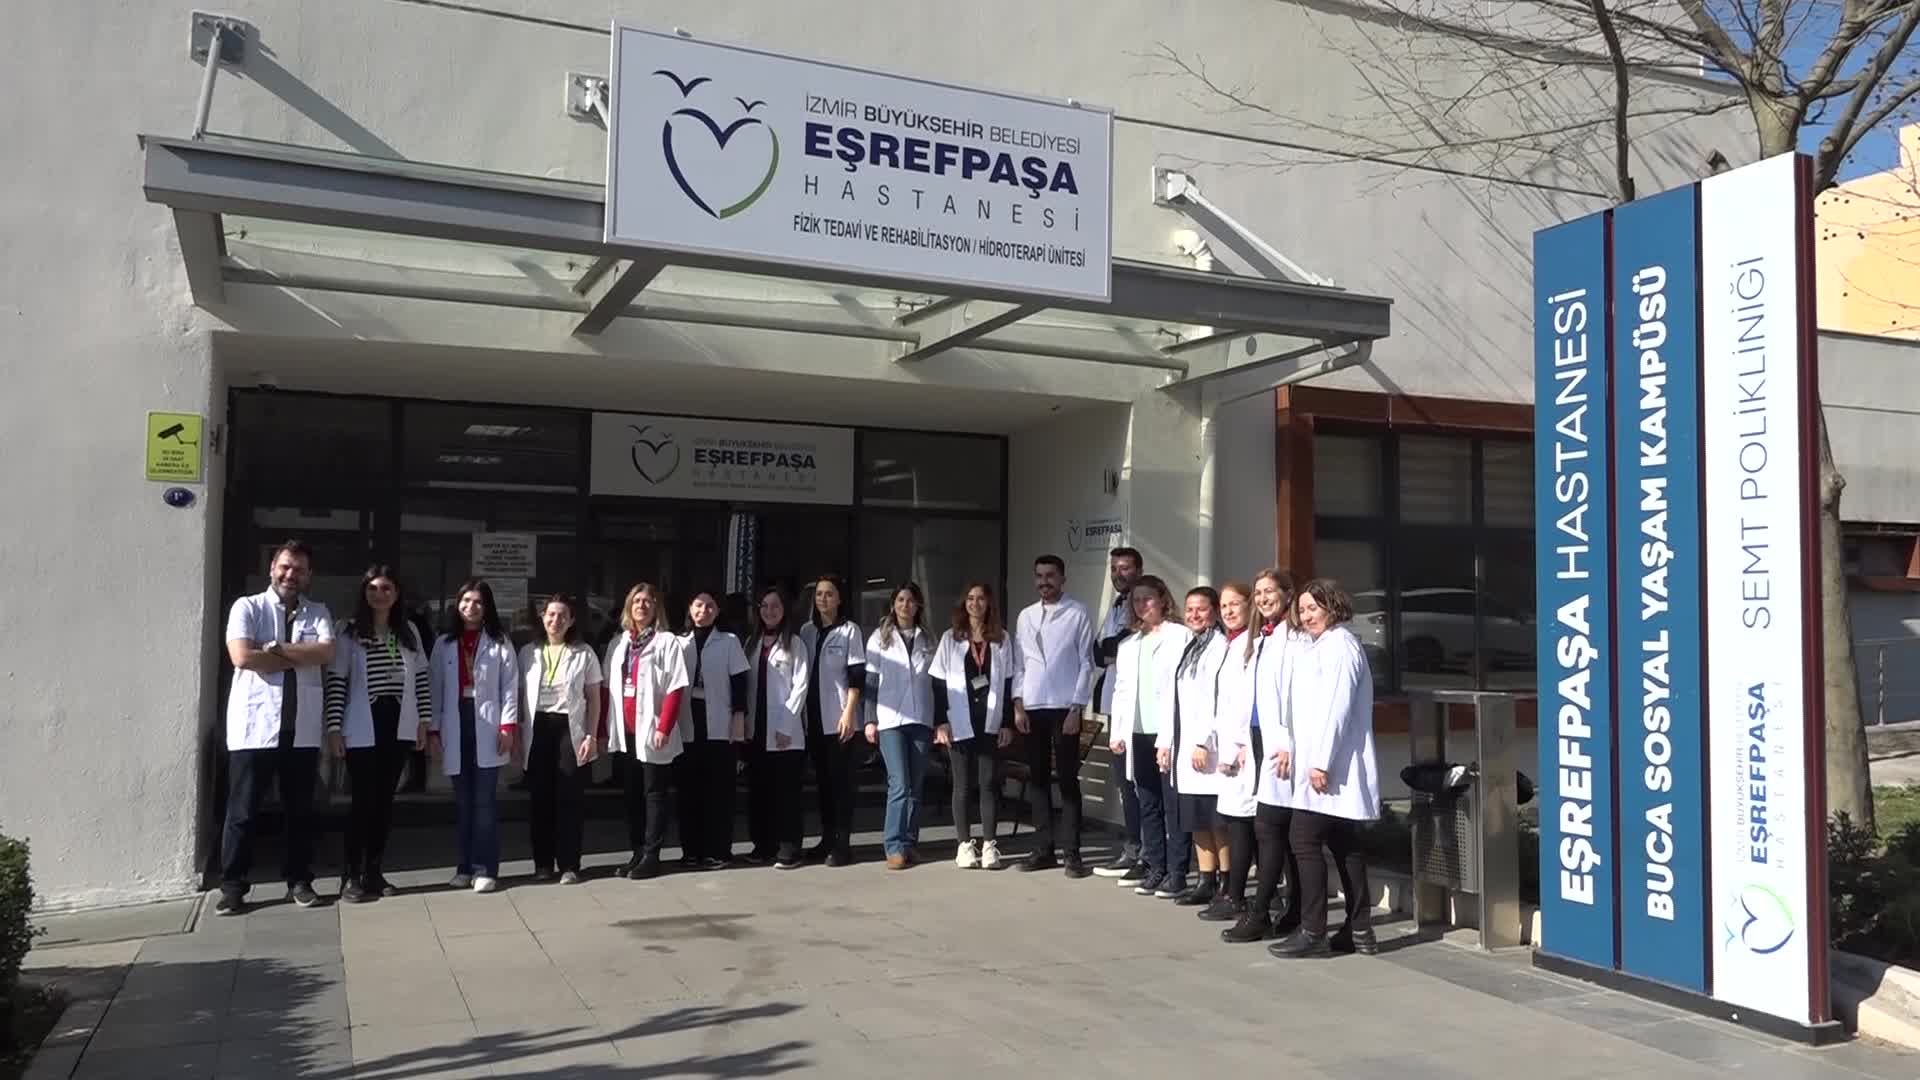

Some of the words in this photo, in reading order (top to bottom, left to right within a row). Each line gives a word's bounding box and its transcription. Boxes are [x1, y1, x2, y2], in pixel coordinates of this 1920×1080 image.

[804, 121, 1080, 200] EŞREFPAŞA
[805, 92, 858, 120] İZMİR
[864, 104, 984, 140] BÜYÜKŞEHİR
[989, 125, 1081, 155] BELEDİYESİ
[793, 214, 821, 234] FİZİK
[823, 218, 862, 240] TEDAVİ
[865, 224, 879, 242] VE
[880, 225, 971, 254] REHABİLİTASYON
[972, 239, 978, 255] /
[978, 235, 1046, 263] HİDROTERAPİ
[1047, 245, 1086, 268] ÜNİTESİ
[804, 173, 1080, 232] HASTANESİ
[1632, 265, 1667, 467] KAMPÜSÜ
[1729, 256, 1769, 500] POLİKLİNİĞİ
[694, 448, 817, 472] EŞREFPAŞA
[1547, 288, 1589, 579] HASTANESİ
[1640, 477, 1674, 621] YAŞAM
[1740, 517, 1771, 630] SEMT
[1556, 594, 1601, 905] EŞREFPAŞA
[1642, 629, 1673, 793] SOSYAL
[1747, 681, 1773, 865] EŞREFPAŞA
[1645, 802, 1675, 921] BUCA
